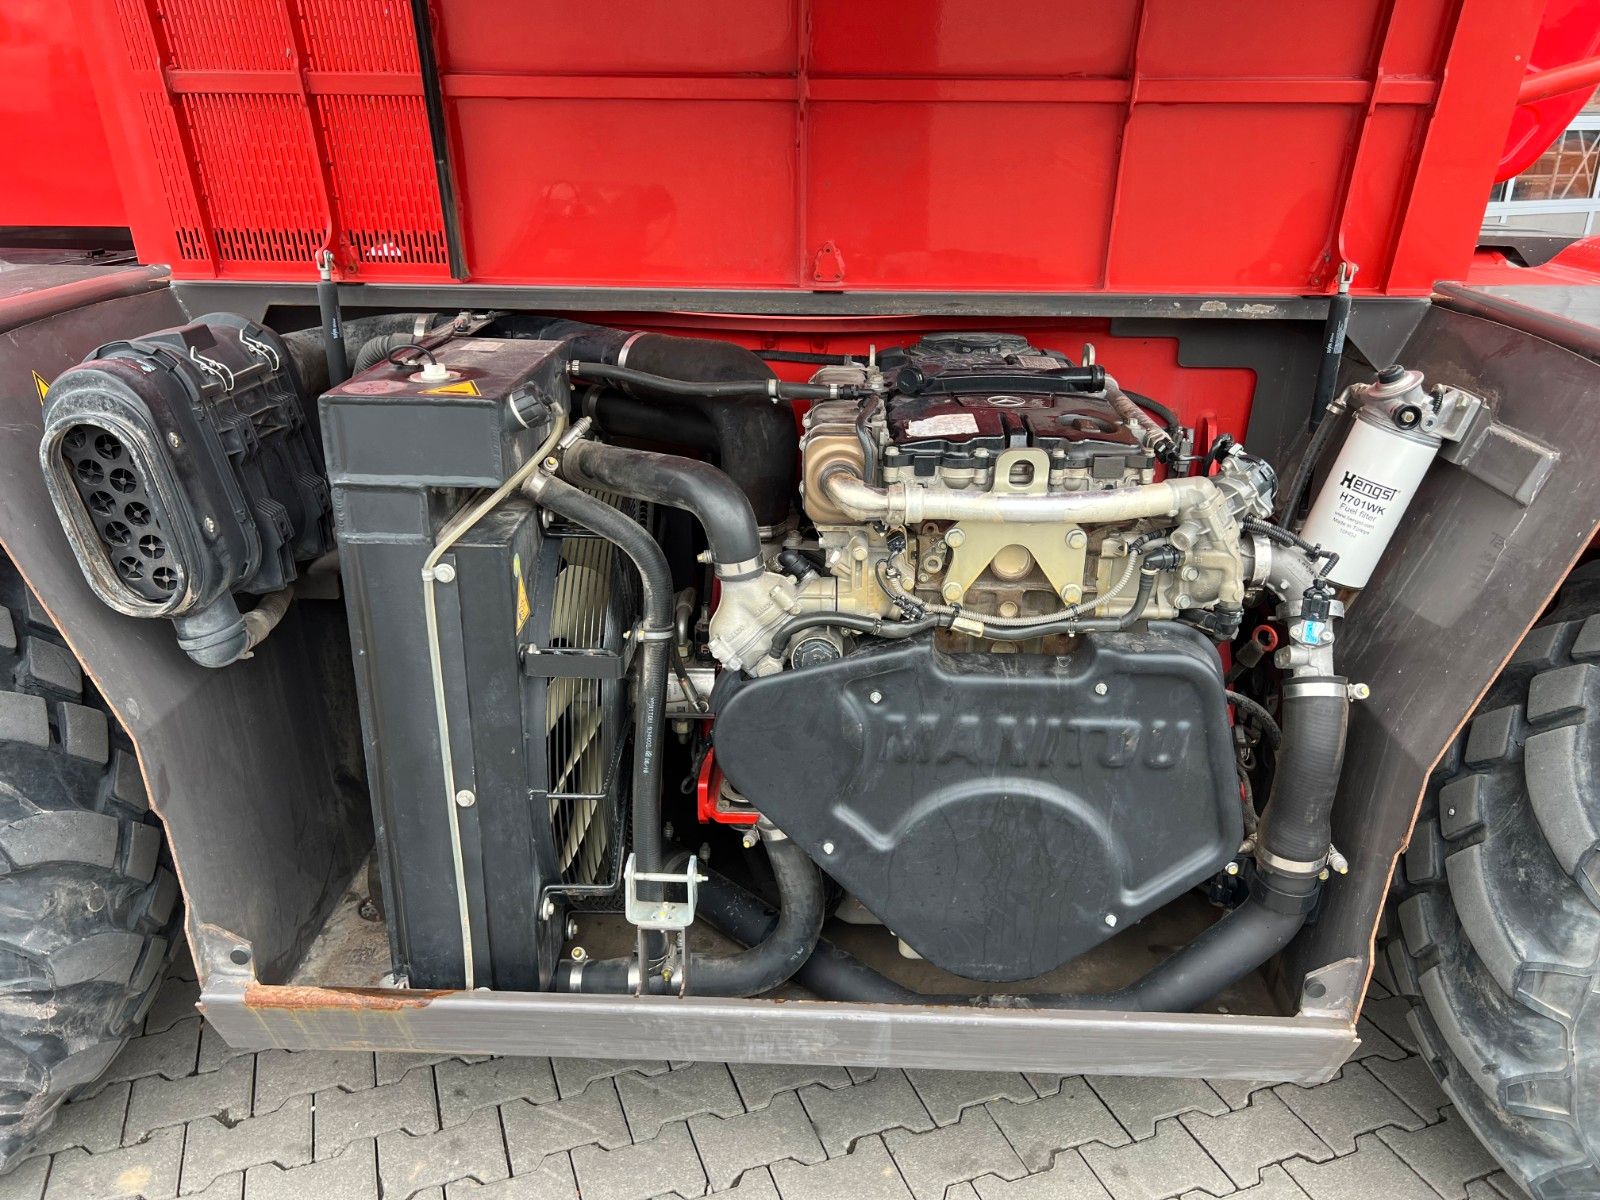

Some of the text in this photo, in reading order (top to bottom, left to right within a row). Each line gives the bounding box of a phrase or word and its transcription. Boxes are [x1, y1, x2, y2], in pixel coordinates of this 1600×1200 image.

[1340, 471, 1397, 501] Hengst
[1340, 492, 1386, 515] H701WK
[1340, 502, 1377, 522] Fuel filter
[880, 713, 1191, 769] MANITOU
